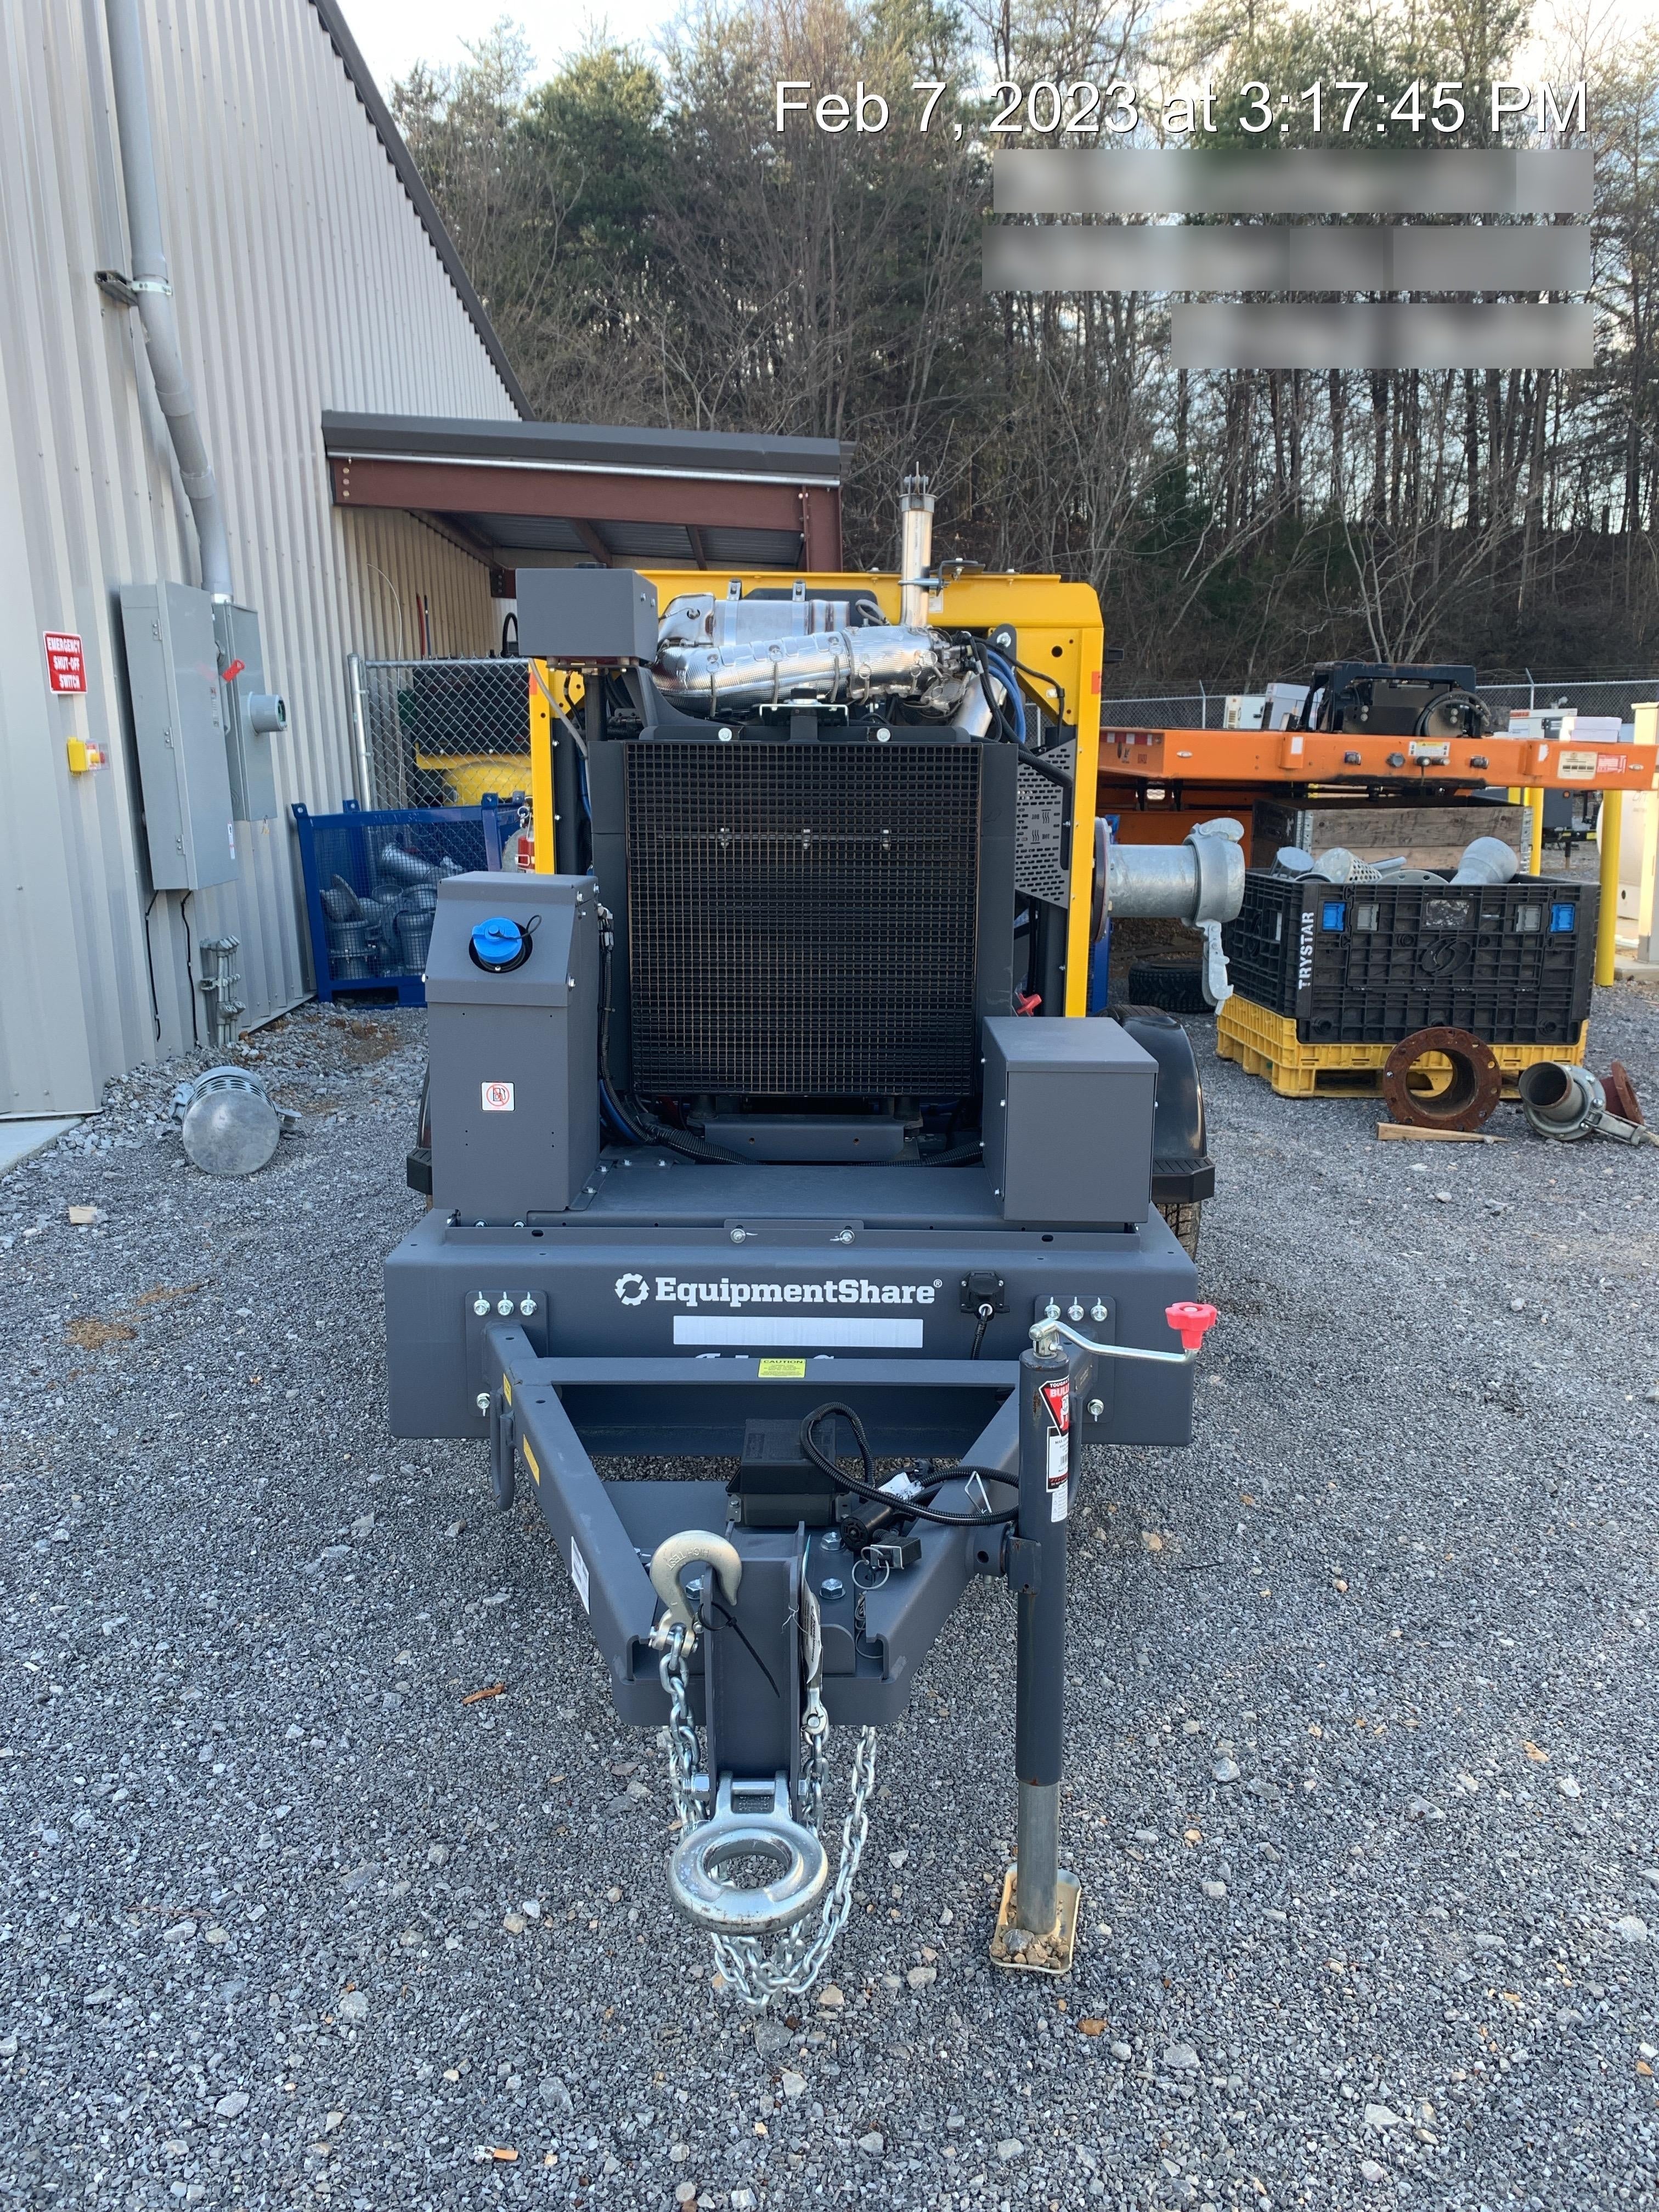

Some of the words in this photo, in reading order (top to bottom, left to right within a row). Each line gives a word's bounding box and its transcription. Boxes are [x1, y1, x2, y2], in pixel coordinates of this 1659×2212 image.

[47, 636, 81, 653] EMERGENCY
[53, 655, 80, 672] SHUT-OFF
[59, 674, 81, 689] SWITCH
[1299, 912, 1314, 990] TRYSTAR
[666, 1551, 687, 1571] TEST
